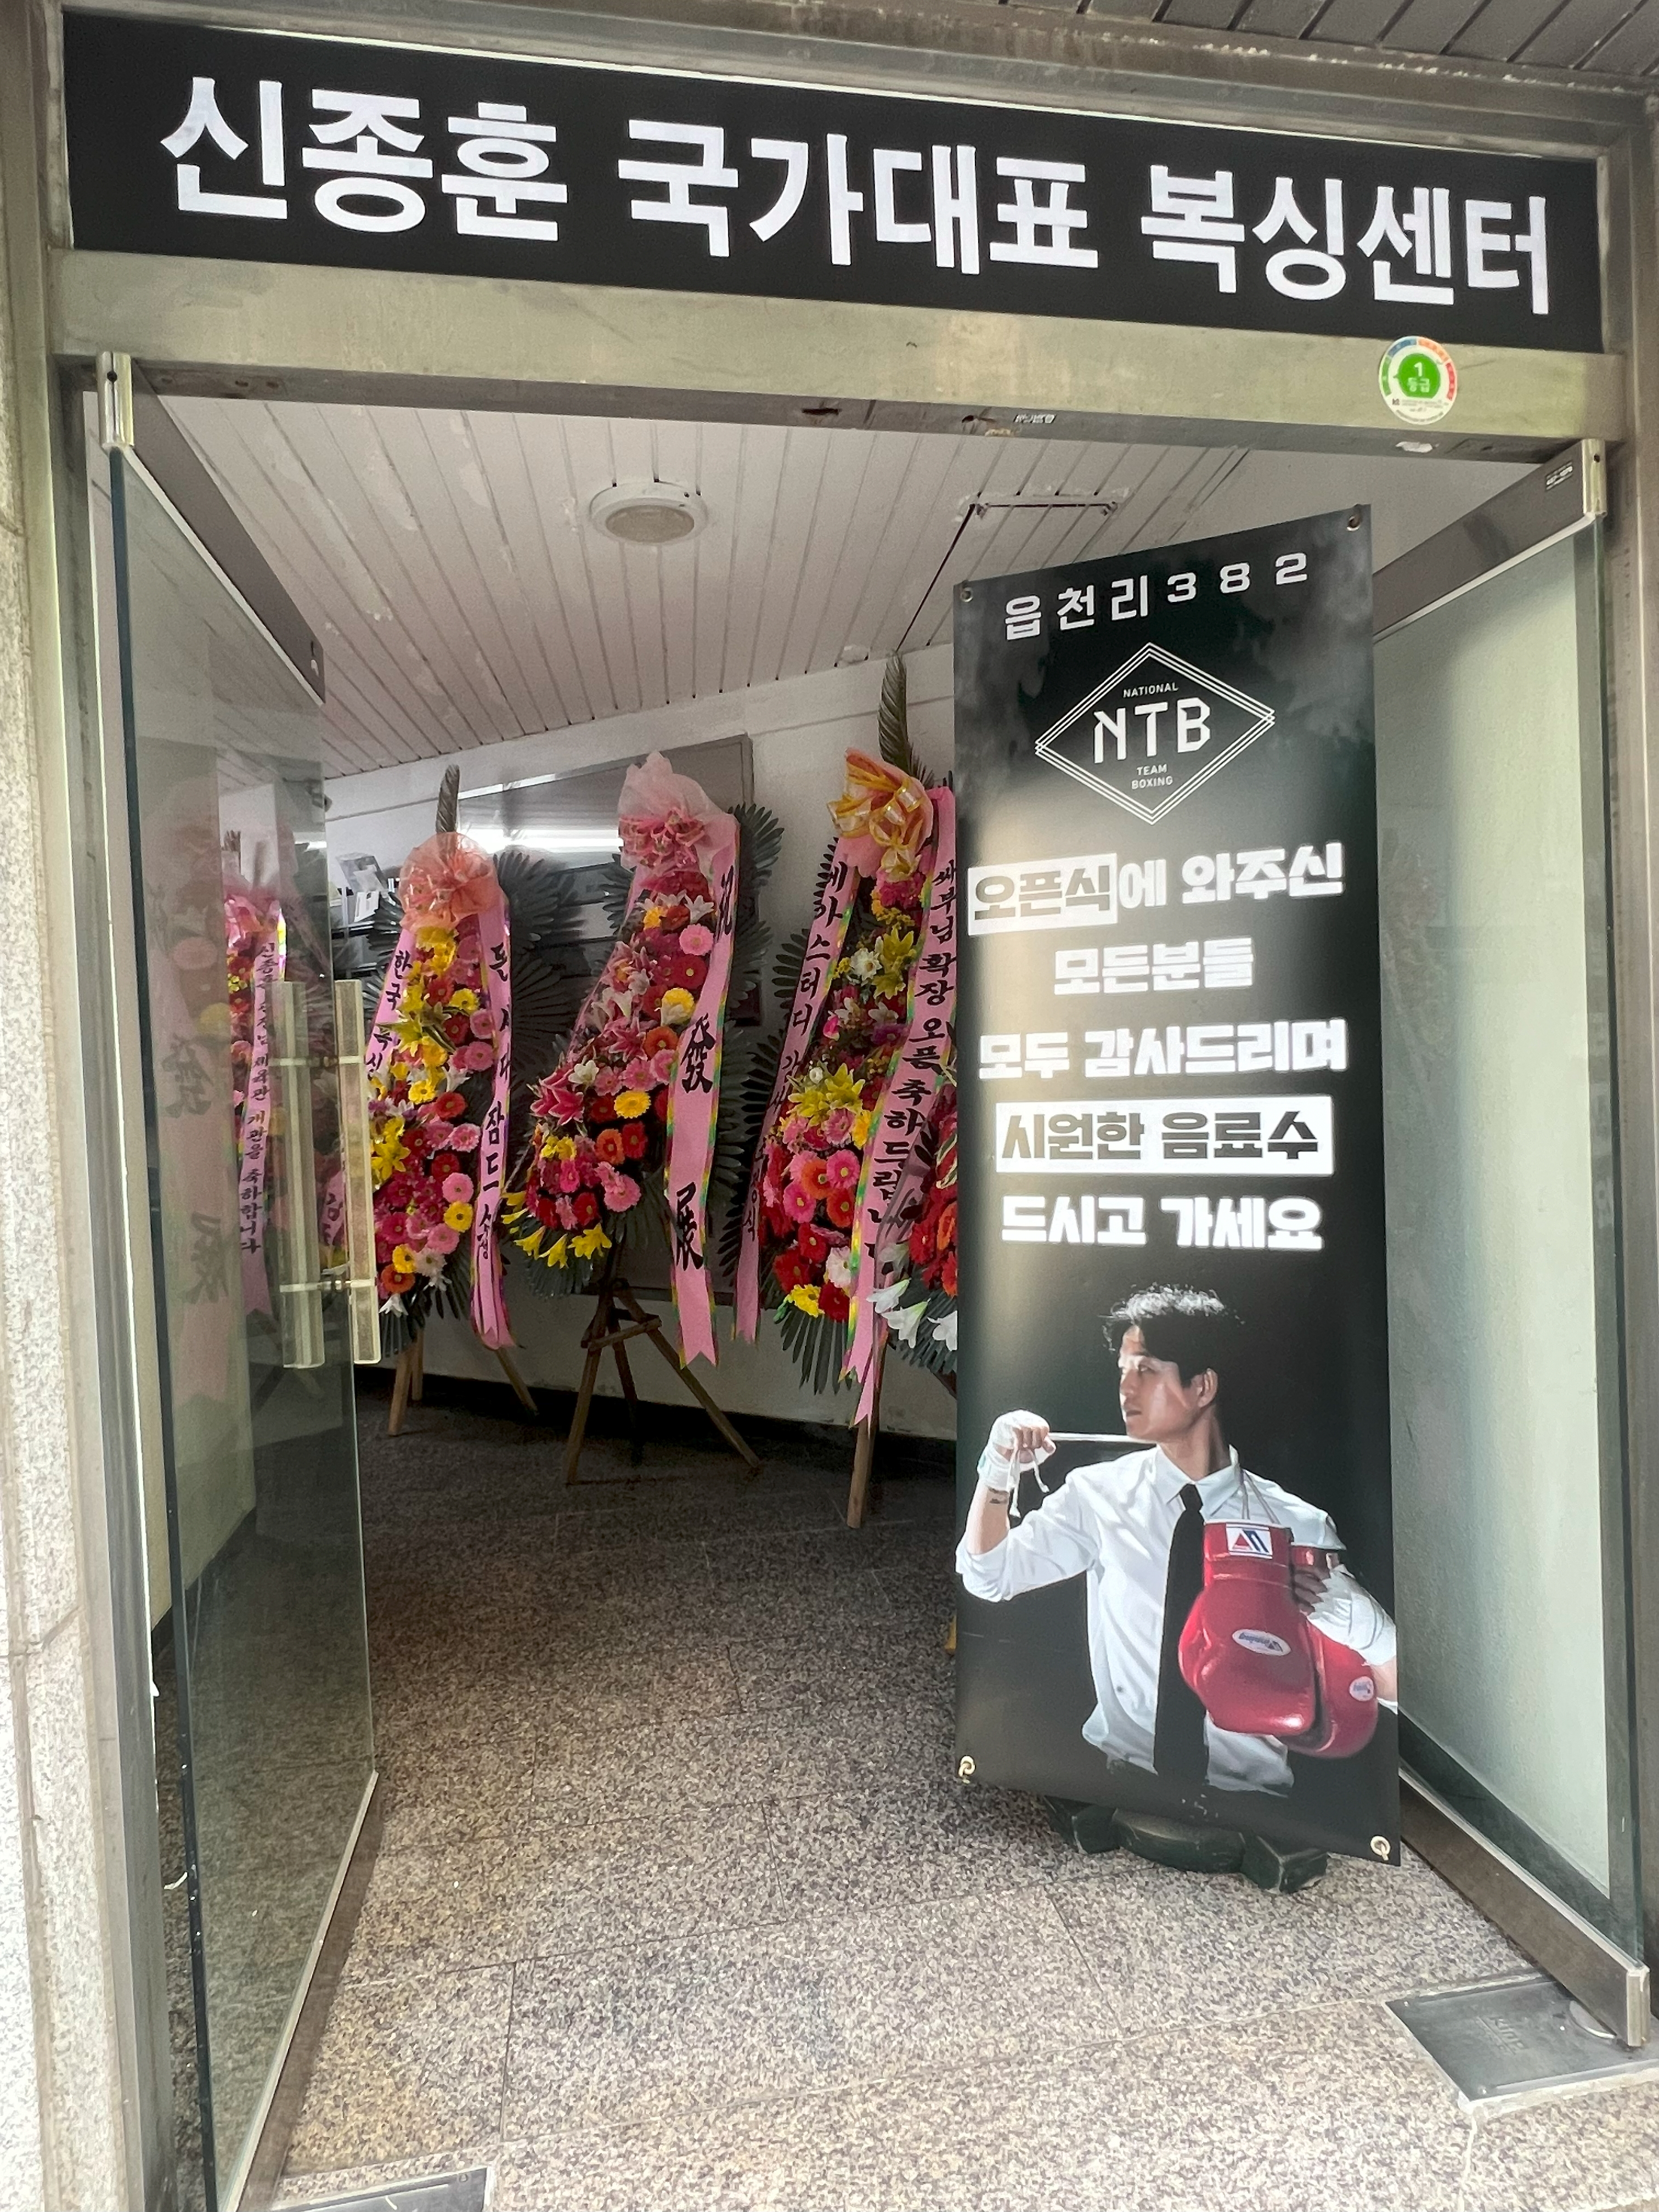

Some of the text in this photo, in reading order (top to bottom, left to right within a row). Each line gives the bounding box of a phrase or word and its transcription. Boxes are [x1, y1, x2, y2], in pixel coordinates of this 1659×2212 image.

[160, 76, 1549, 315] 신종훈 국가대표 복싱센터
[1413, 362, 1424, 377] 1
[1122, 682, 1179, 698] NATIONAL
[1093, 697, 1211, 764] NTB
[1131, 776, 1173, 790] BOXING
[1136, 764, 1167, 776] TEAM
[974, 840, 1344, 921] 오픈식에 와주신
[1054, 937, 1254, 995] 모든분들
[979, 1017, 1348, 1080] 모두 감사드리며
[1001, 1110, 1318, 1160] 시원한 음료수
[1001, 1195, 1323, 1250] 드시고 가세요
